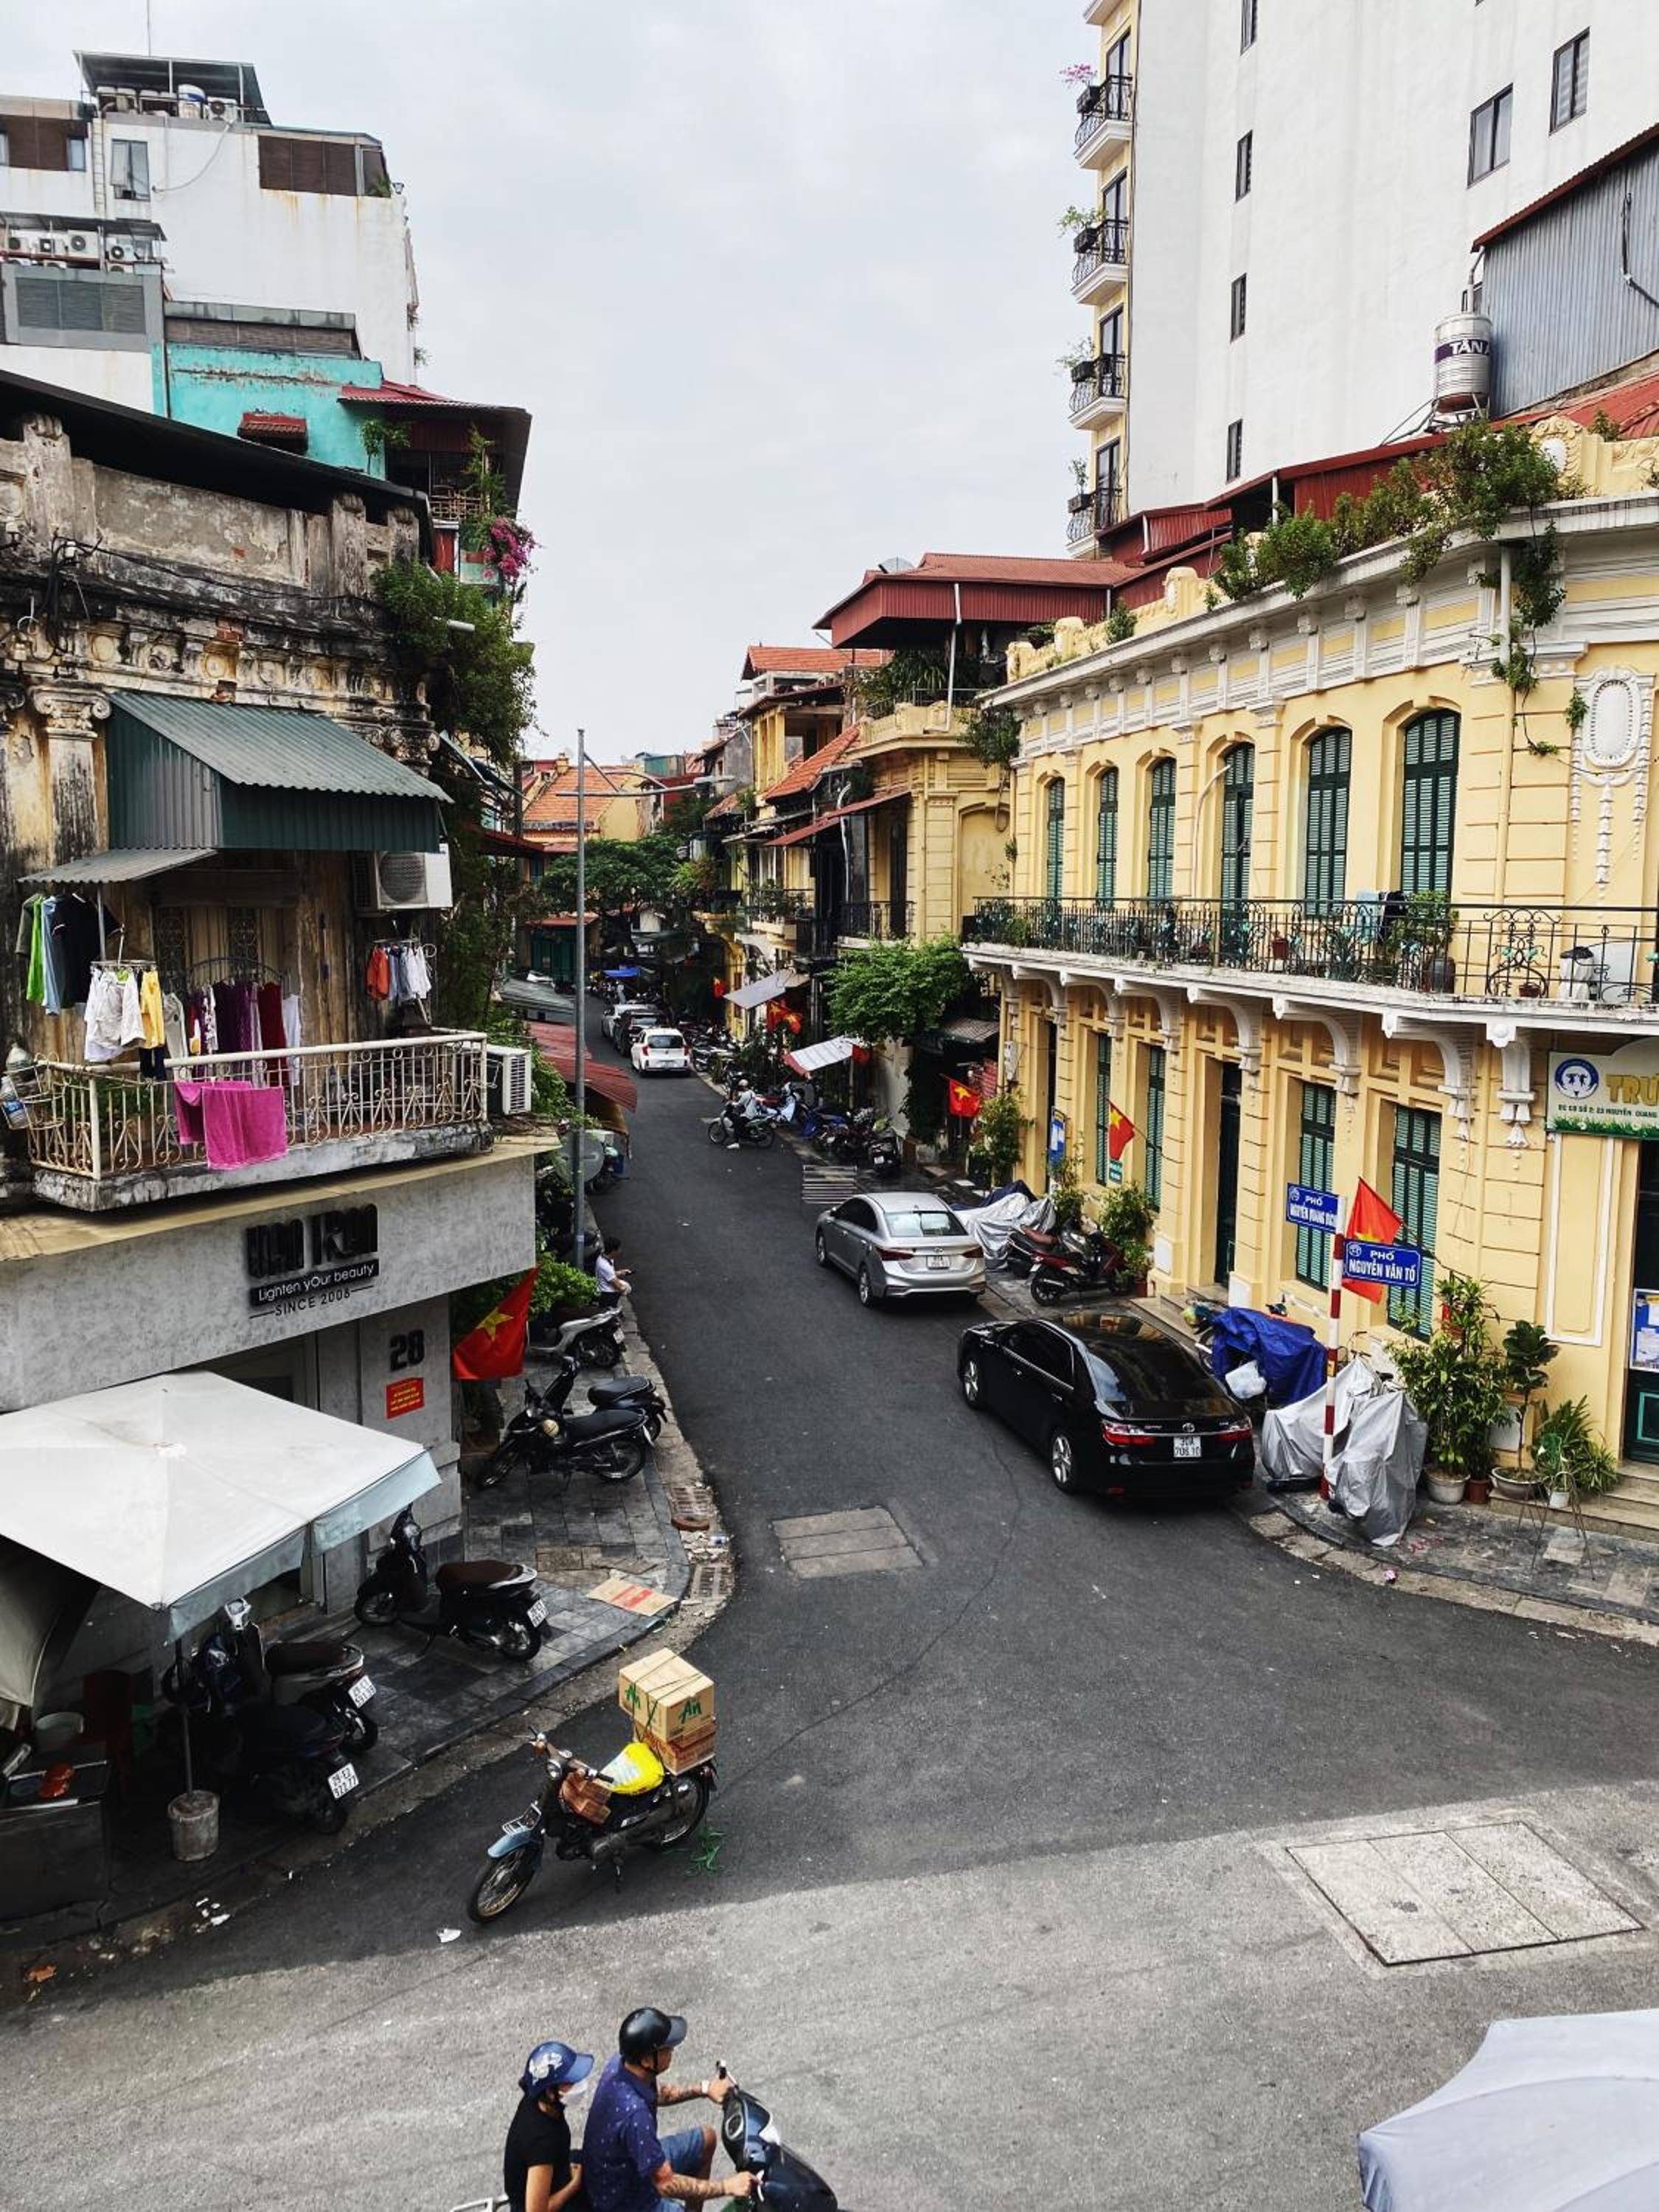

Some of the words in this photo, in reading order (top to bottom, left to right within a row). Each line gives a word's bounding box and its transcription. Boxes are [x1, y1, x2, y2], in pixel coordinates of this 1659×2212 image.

[1370, 1250, 1394, 1260] PHỐ
[1349, 1259, 1383, 1277] NGUYỄN
[1385, 1264, 1403, 1280] VĂN
[1405, 1265, 1416, 1281] TỐ
[259, 1281, 299, 1302] Lighten
[334, 1263, 375, 1282] beauty
[275, 1296, 316, 1316] SINCE
[390, 1329, 425, 1371] 28
